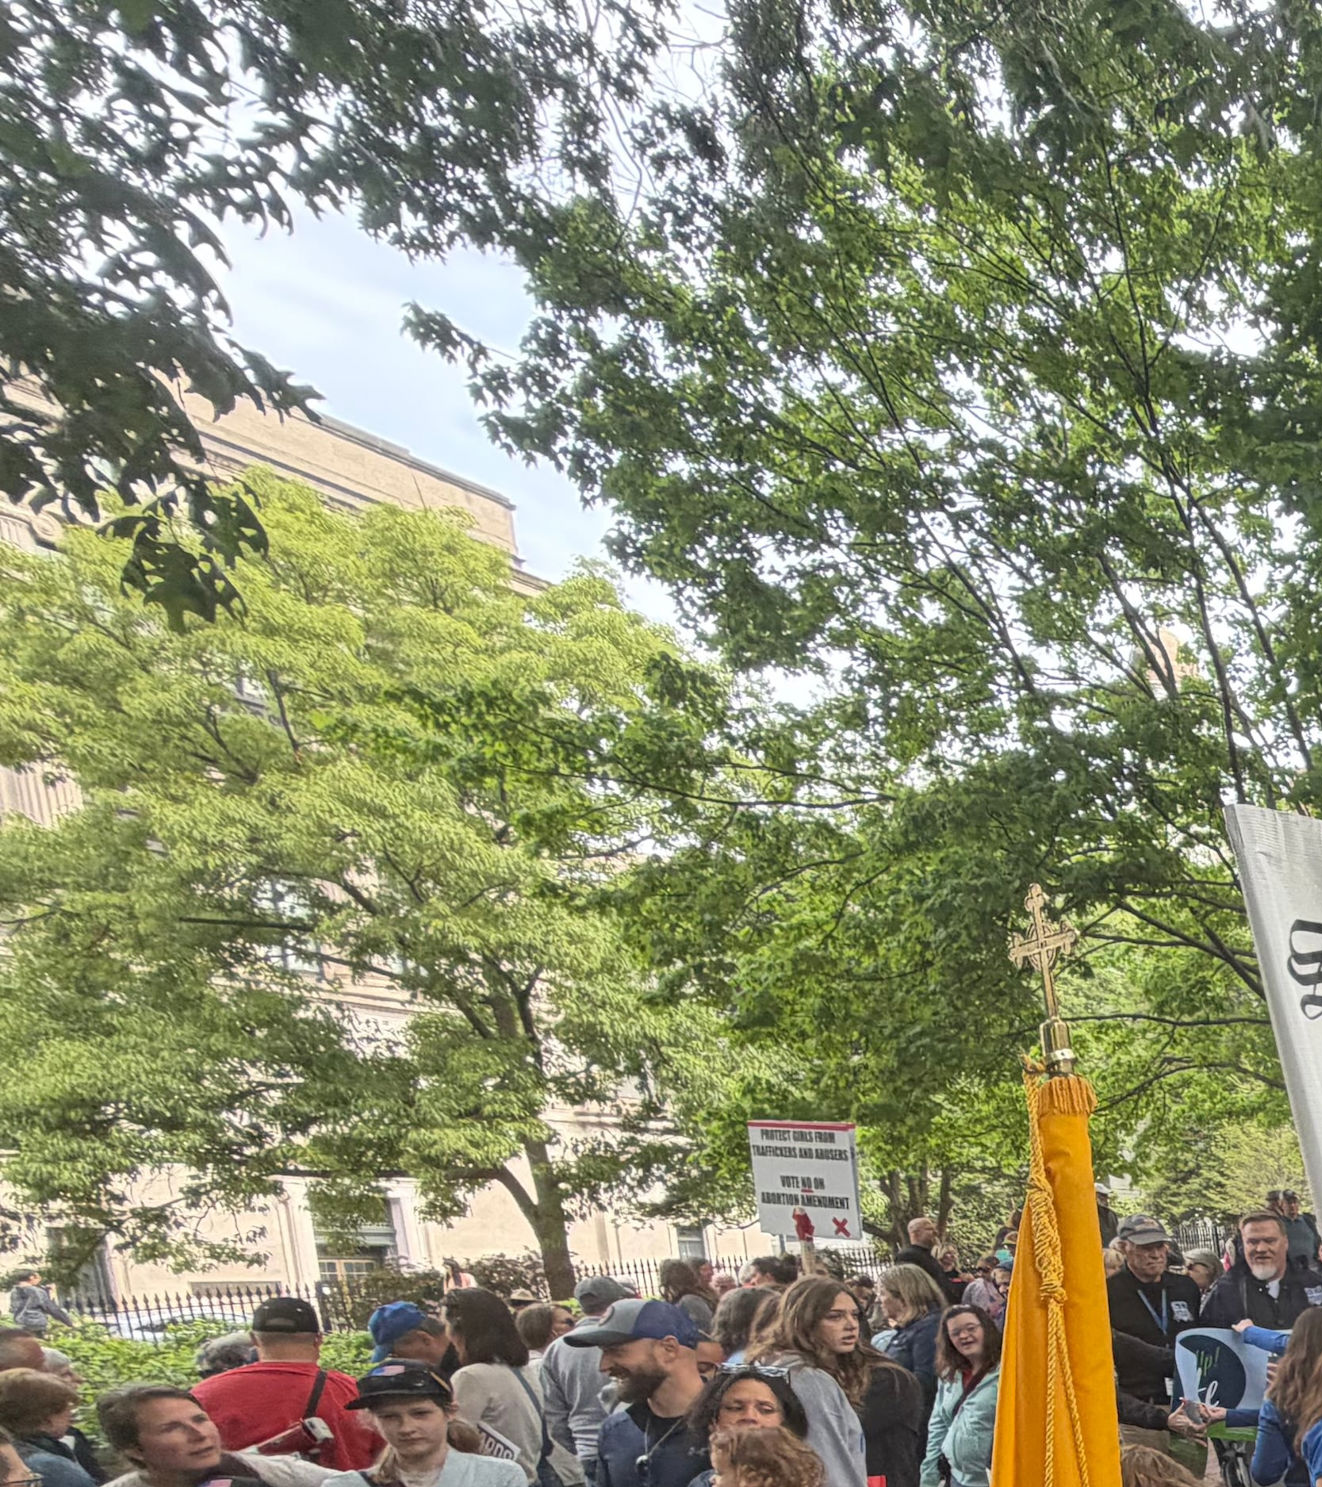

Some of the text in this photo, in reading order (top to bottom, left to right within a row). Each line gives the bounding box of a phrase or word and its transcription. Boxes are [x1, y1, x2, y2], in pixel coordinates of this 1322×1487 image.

[760, 1129, 836, 1143] PROTECT GIRLS FROM
[752, 1144, 849, 1161] TRAFFICKERS AND ABUSERS
[780, 1175, 825, 1190] VOTE NO ON
[761, 1191, 849, 1210] ABORTION AMENDMENT
